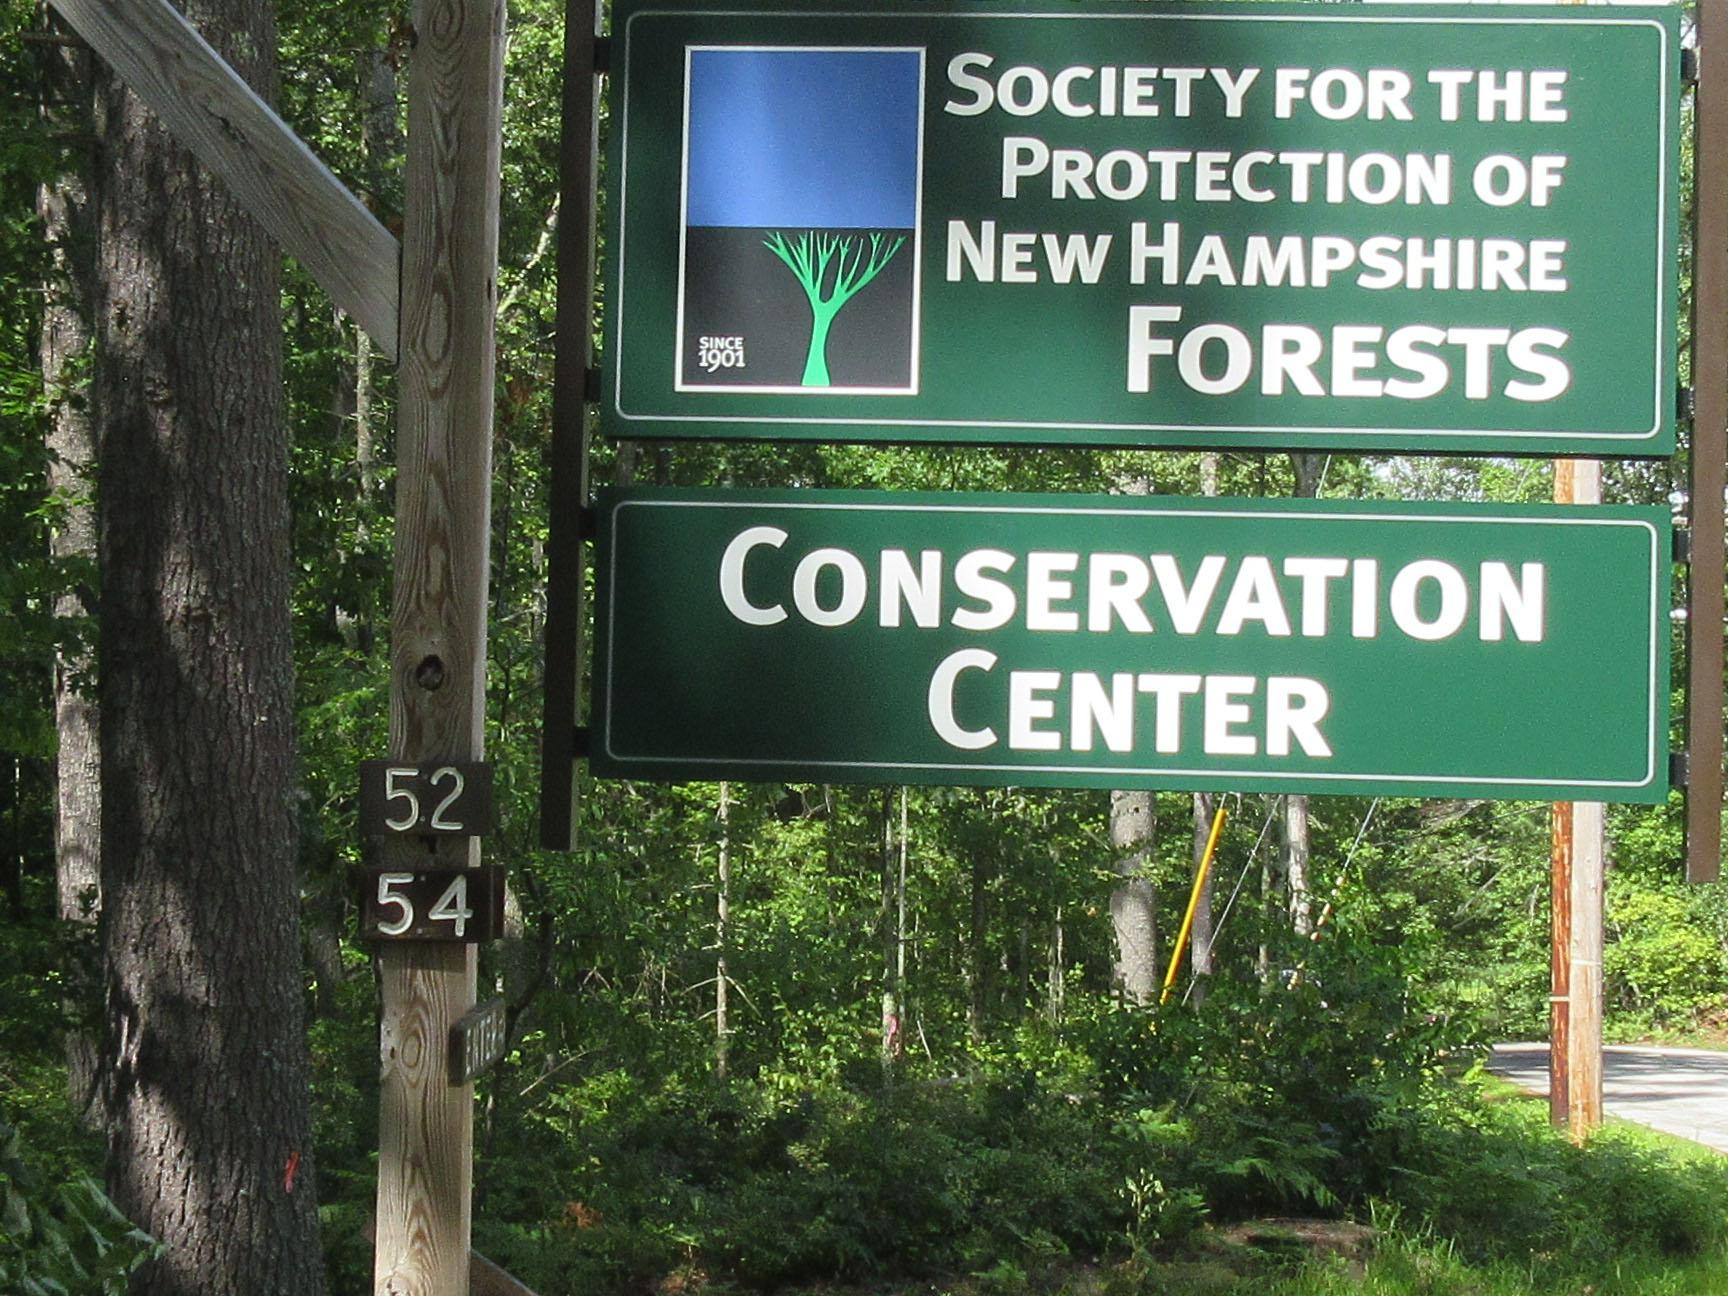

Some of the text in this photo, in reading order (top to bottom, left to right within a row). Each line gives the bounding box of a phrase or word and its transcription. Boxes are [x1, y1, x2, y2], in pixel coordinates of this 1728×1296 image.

[943, 51, 1573, 124] SOCIETY FOR THE
[1000, 135, 1569, 209] PROTECTION OF
[945, 219, 1571, 294] NEW HAMPSHIRE
[698, 336, 744, 350] SINCE
[698, 349, 746, 373] 1901
[1125, 304, 1575, 404] FORESTS
[718, 525, 1549, 645] CONSERVATION
[927, 646, 1335, 759] CENTER
[385, 766, 465, 832] 52
[377, 871, 474, 937] 54
